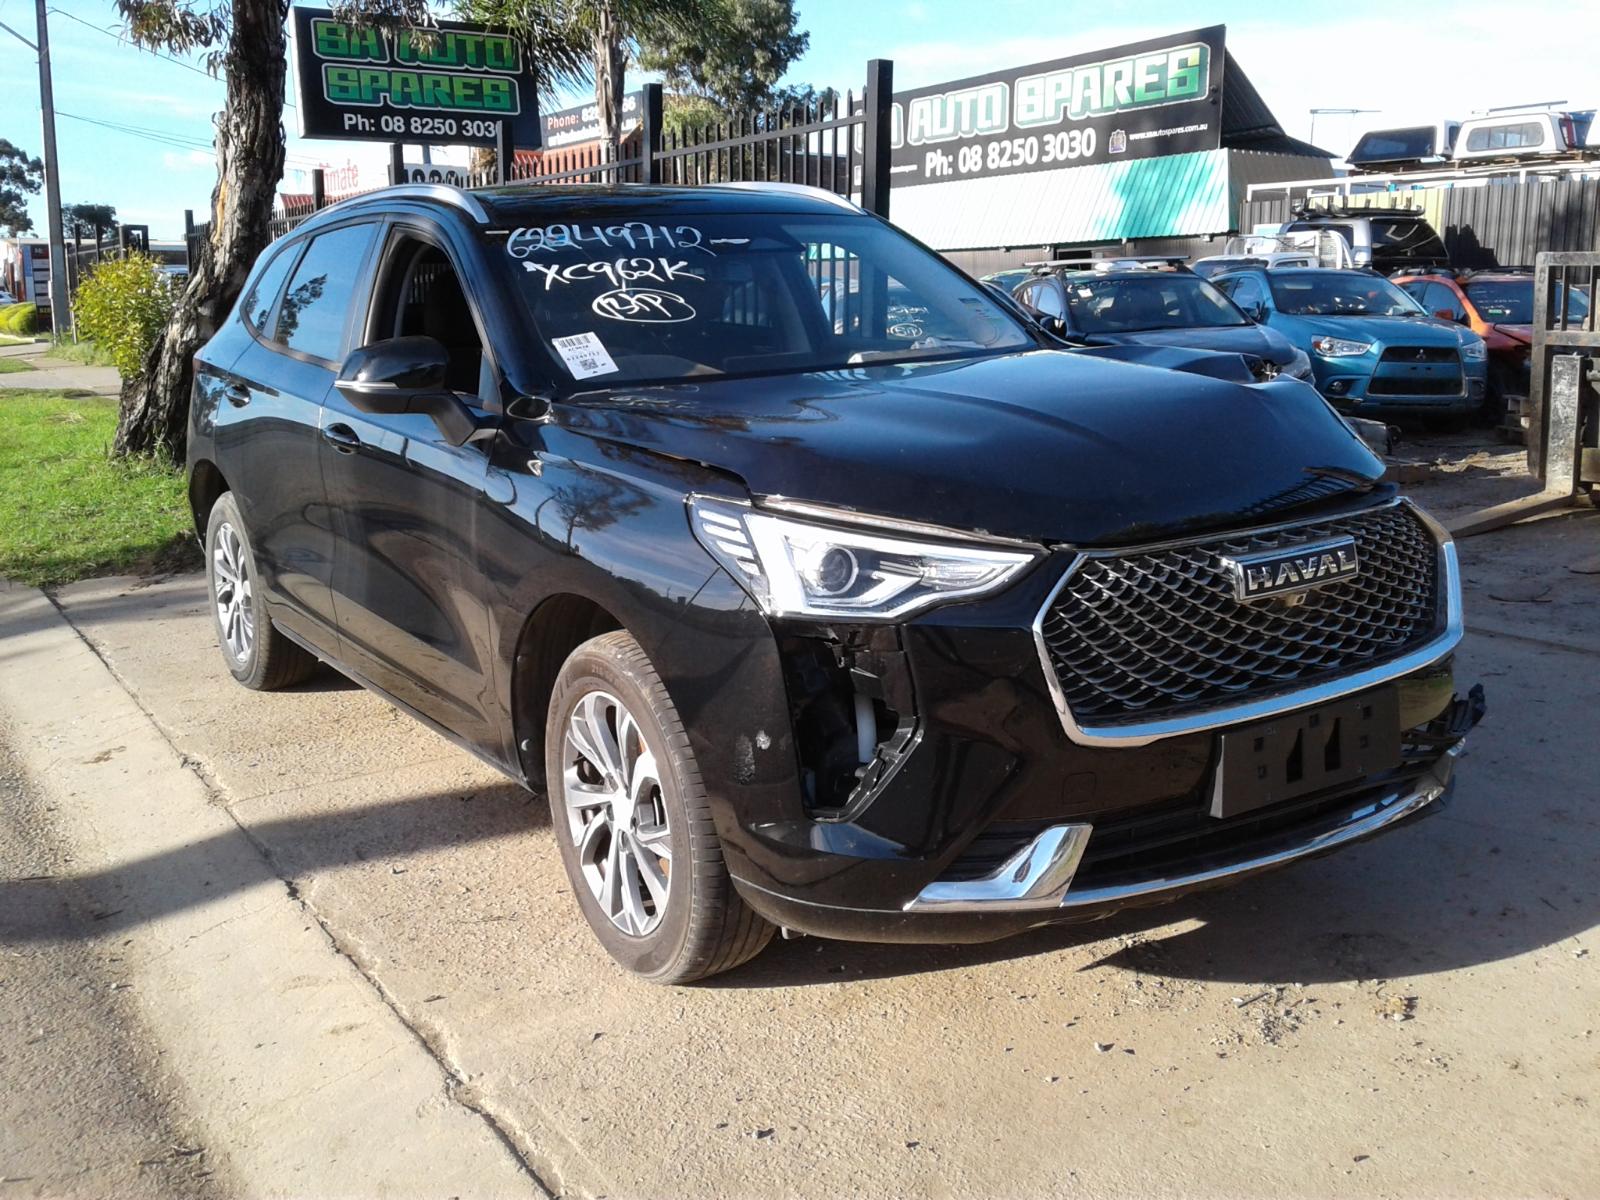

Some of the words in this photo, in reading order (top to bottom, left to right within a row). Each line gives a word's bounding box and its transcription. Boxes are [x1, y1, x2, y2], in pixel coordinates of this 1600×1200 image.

[313, 20, 382, 61] SA
[398, 28, 517, 70] AUTO
[325, 66, 513, 110] SPARES
[910, 85, 1005, 142] AUTO
[1016, 46, 1204, 127] SPARES
[343, 113, 375, 132] Ph:
[380, 114, 405, 134] 08
[410, 117, 457, 136] 8250
[462, 119, 499, 138] 303
[547, 114, 579, 130] Phone:
[925, 148, 954, 178] Ph:
[958, 144, 982, 174] 08
[987, 136, 1038, 169] 8250
[1042, 127, 1096, 163] 3030
[1247, 550, 1356, 591] HAVAL
